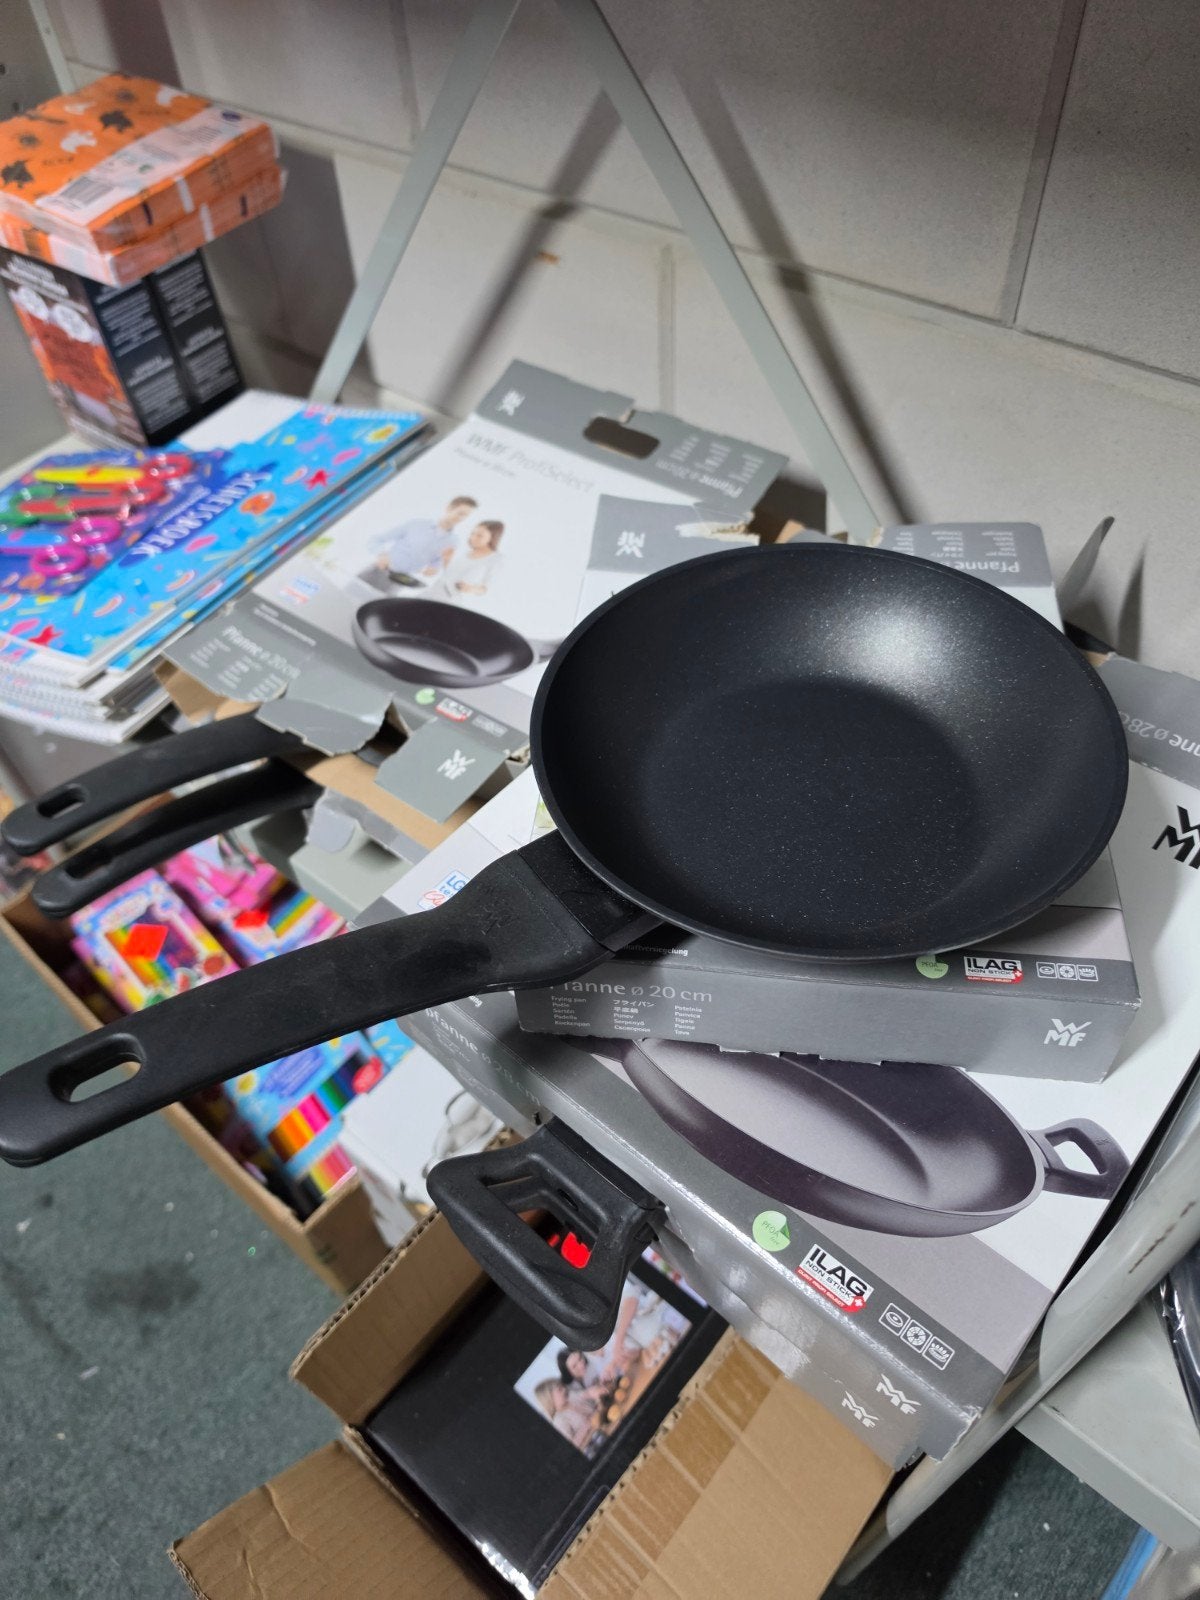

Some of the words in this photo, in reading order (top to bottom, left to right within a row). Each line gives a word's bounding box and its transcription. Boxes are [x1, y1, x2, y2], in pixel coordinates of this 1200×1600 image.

[954, 561, 1019, 572] Pfanne
[1128, 718, 1153, 739] 28
[966, 957, 1018, 970] ILAG
[550, 981, 626, 995] fanne
[650, 986, 676, 998] 20
[681, 991, 712, 1003] cm
[1044, 1018, 1092, 1047] WMF
[805, 1261, 825, 1277] NON
[826, 1277, 853, 1298] STICK
[808, 1248, 867, 1297] ILAG
